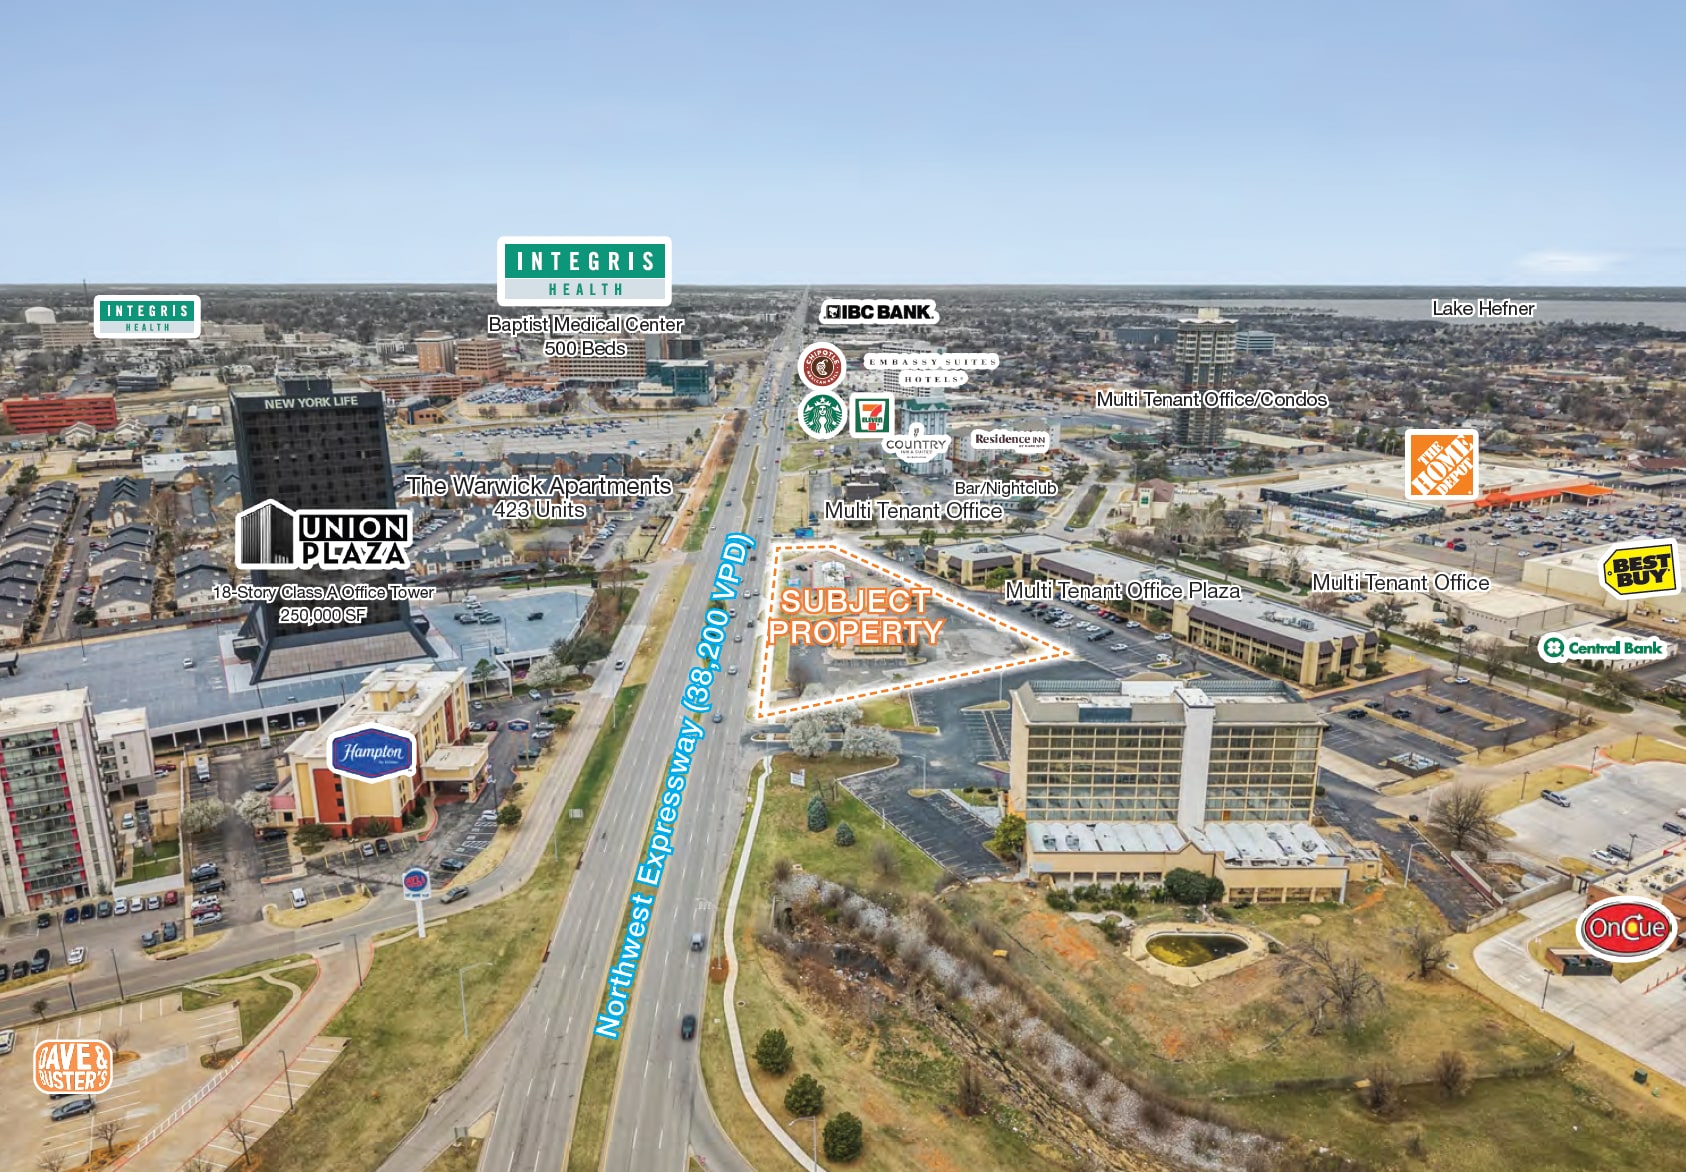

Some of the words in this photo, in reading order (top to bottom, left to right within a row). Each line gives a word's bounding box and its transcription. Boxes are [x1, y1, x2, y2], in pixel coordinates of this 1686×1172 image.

[264, 399, 295, 410] NEW
[297, 397, 332, 408] YORK
[334, 395, 359, 407] LIFE
